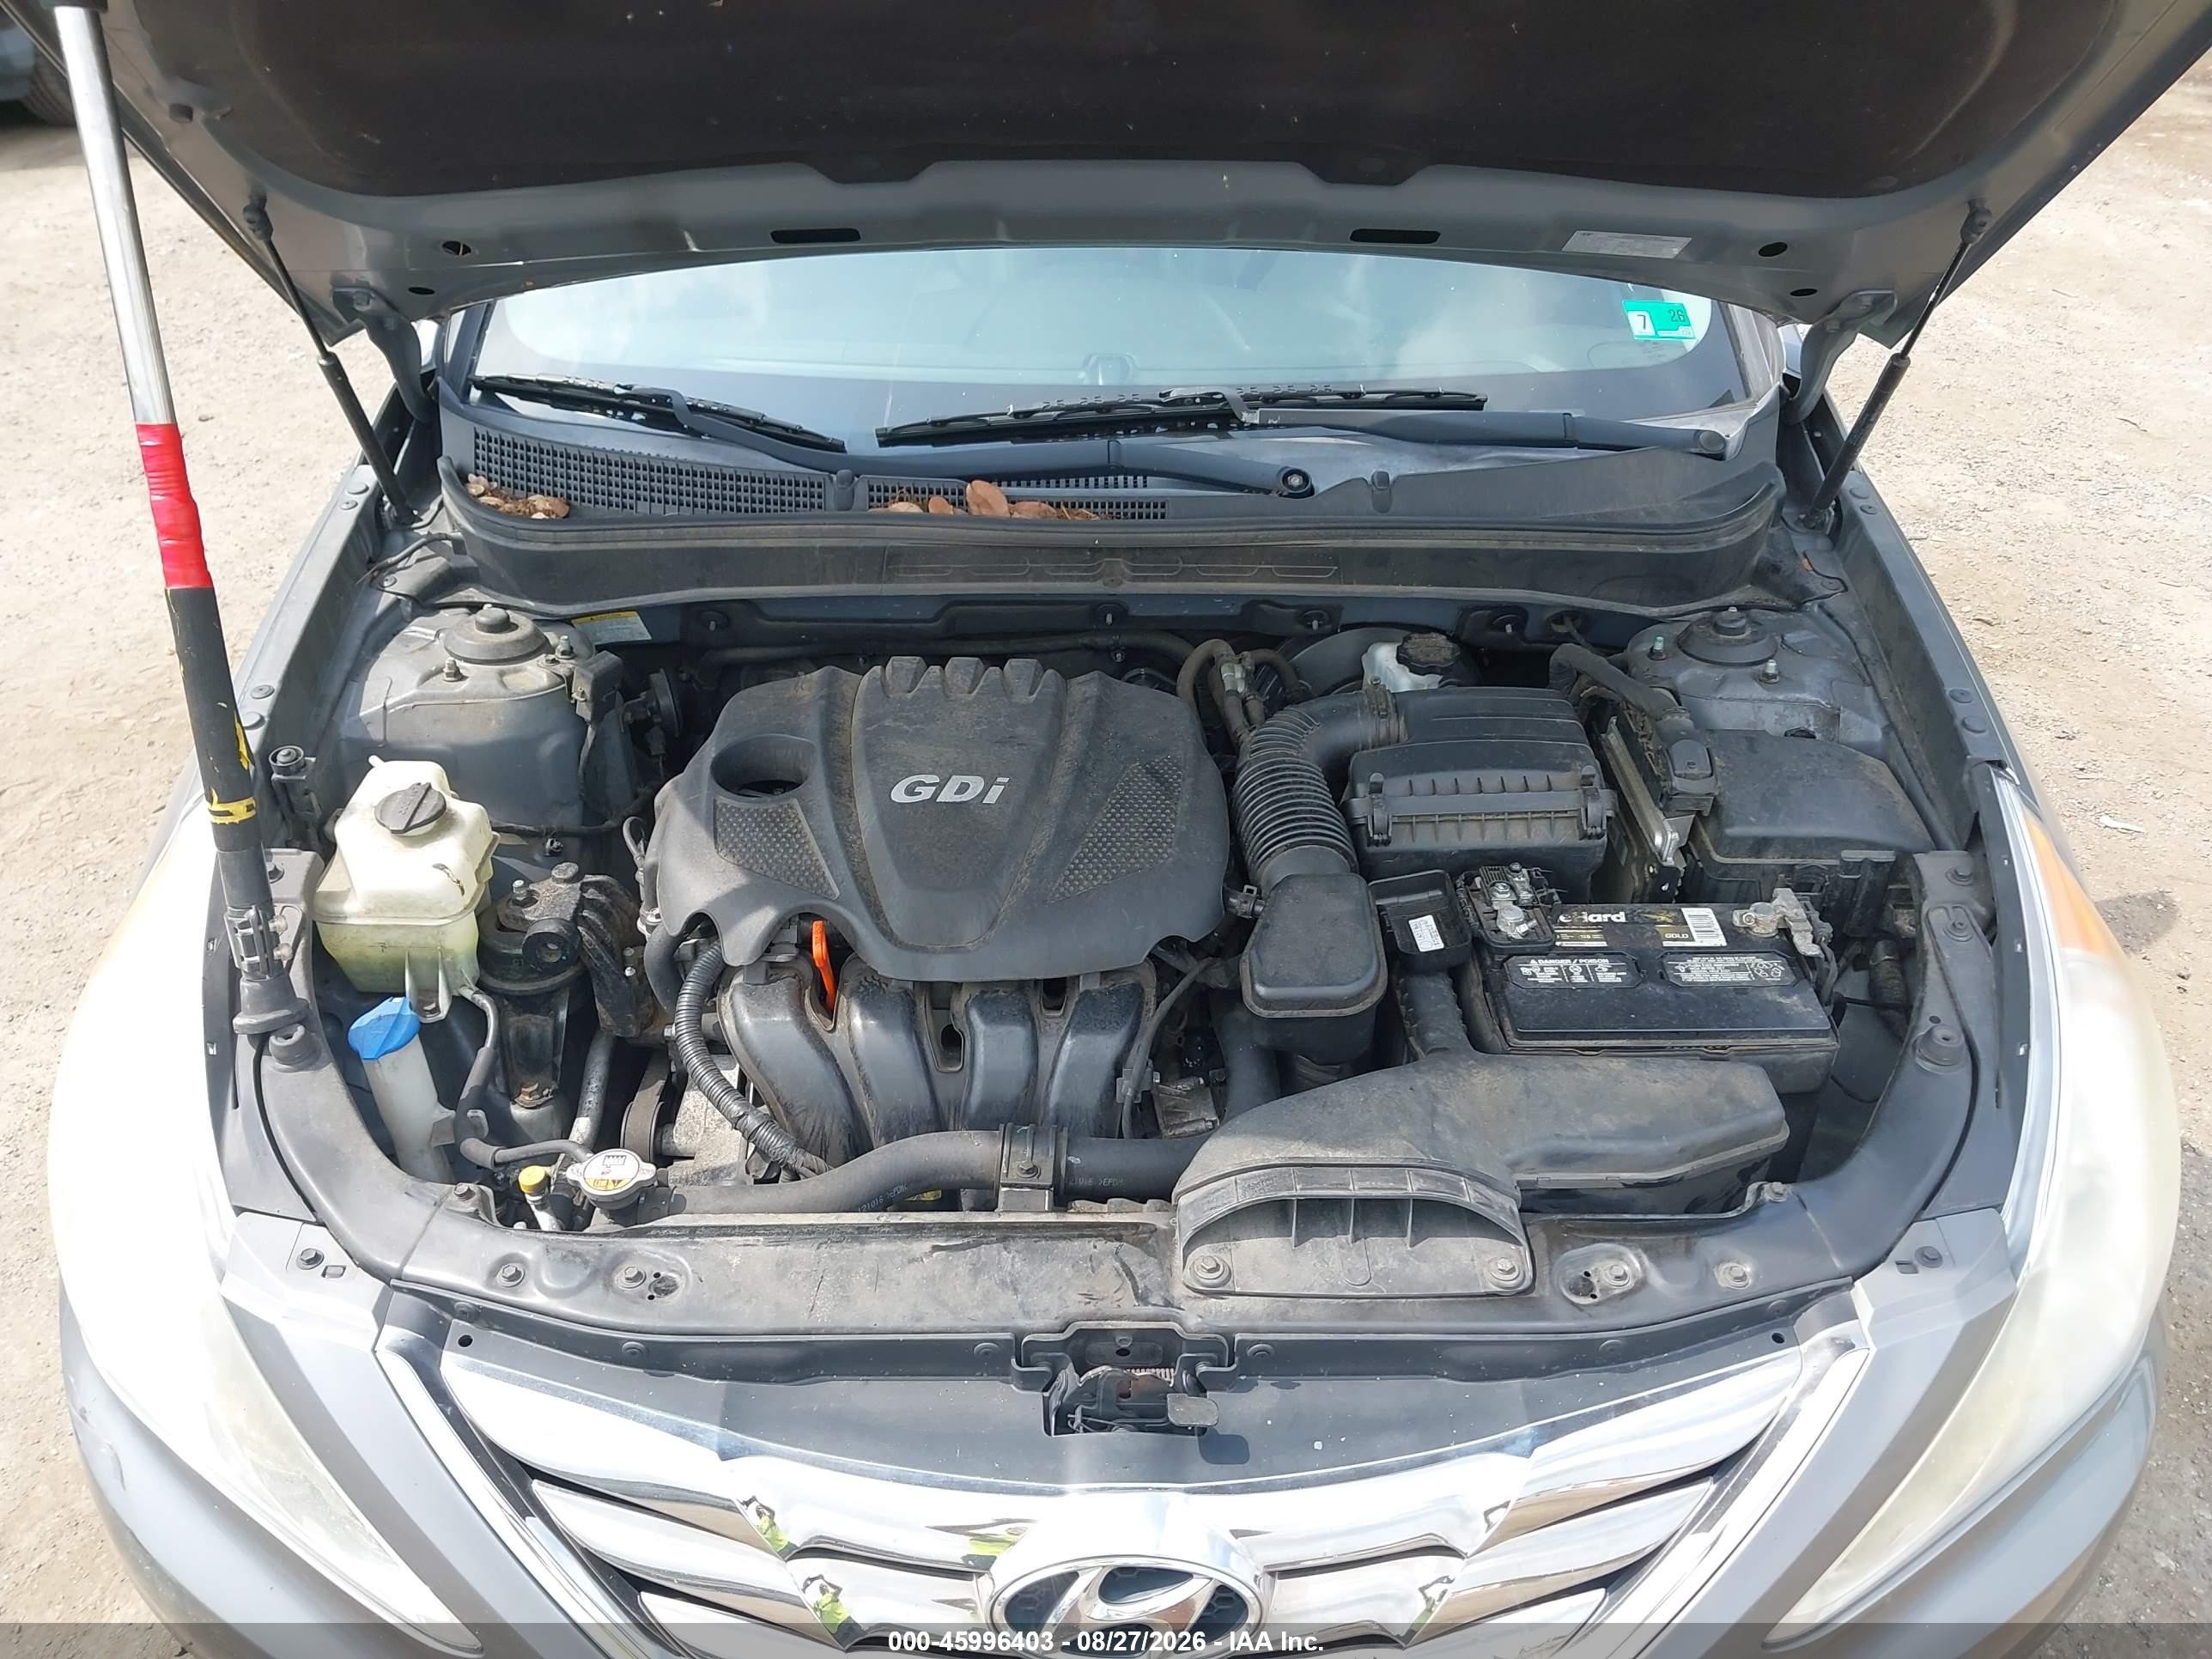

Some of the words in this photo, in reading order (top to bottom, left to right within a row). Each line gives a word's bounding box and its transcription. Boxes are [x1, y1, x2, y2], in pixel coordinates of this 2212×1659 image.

[1636, 313, 1646, 331] 7
[1668, 308, 1686, 323] 26
[890, 774, 1012, 805] GDi
